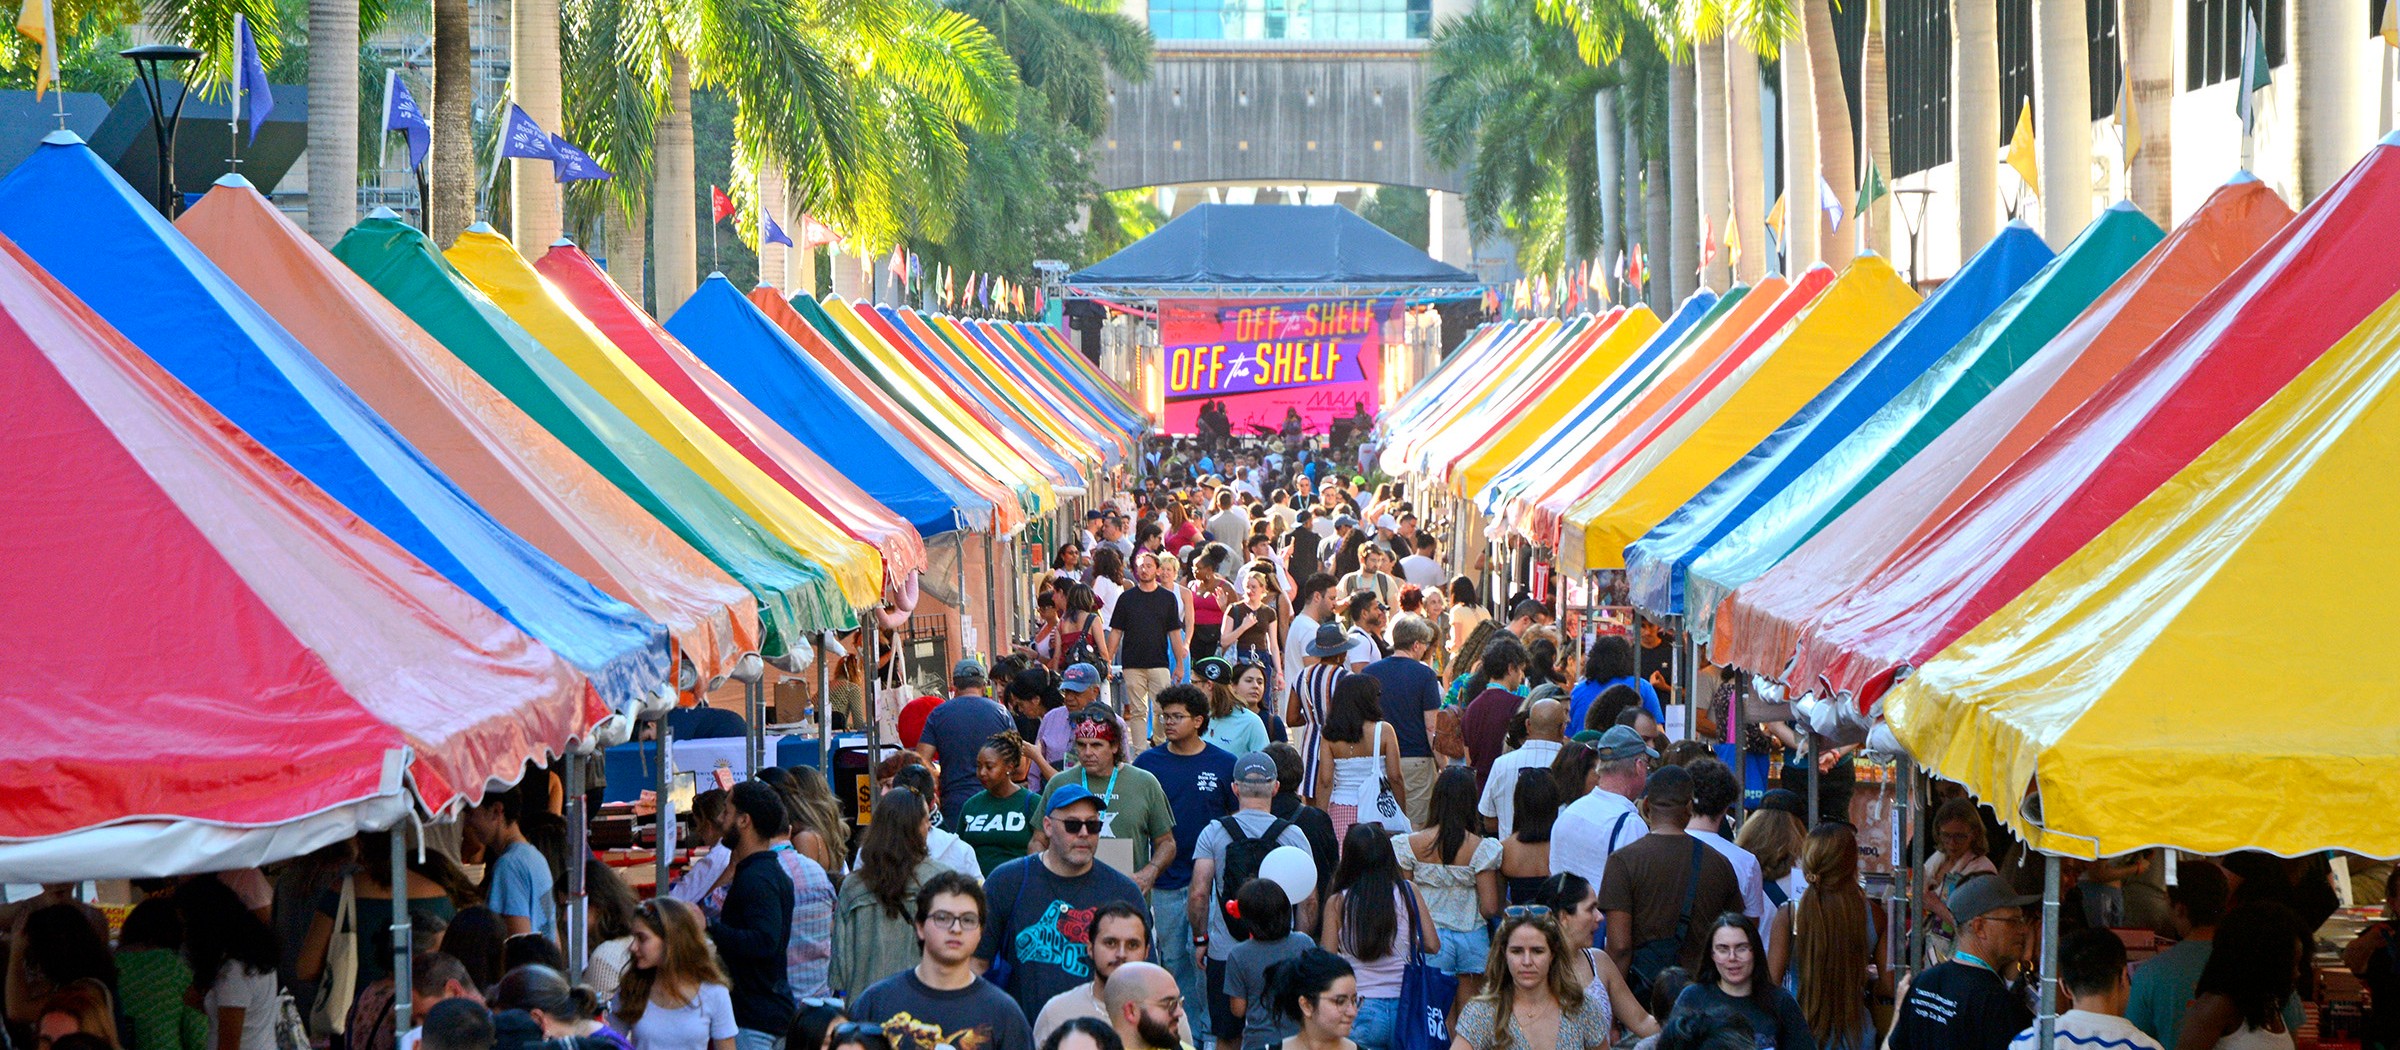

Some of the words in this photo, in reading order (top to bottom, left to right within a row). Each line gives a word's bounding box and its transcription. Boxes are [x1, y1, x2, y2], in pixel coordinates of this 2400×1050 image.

[516, 123, 534, 135] Book
[1236, 306, 1281, 342] OFF
[1304, 298, 1378, 337] SHELF
[1170, 345, 1228, 392] OFF
[1223, 352, 1257, 389] the
[1254, 340, 1342, 386] SHELF
[1306, 391, 1371, 407] MIAMI
